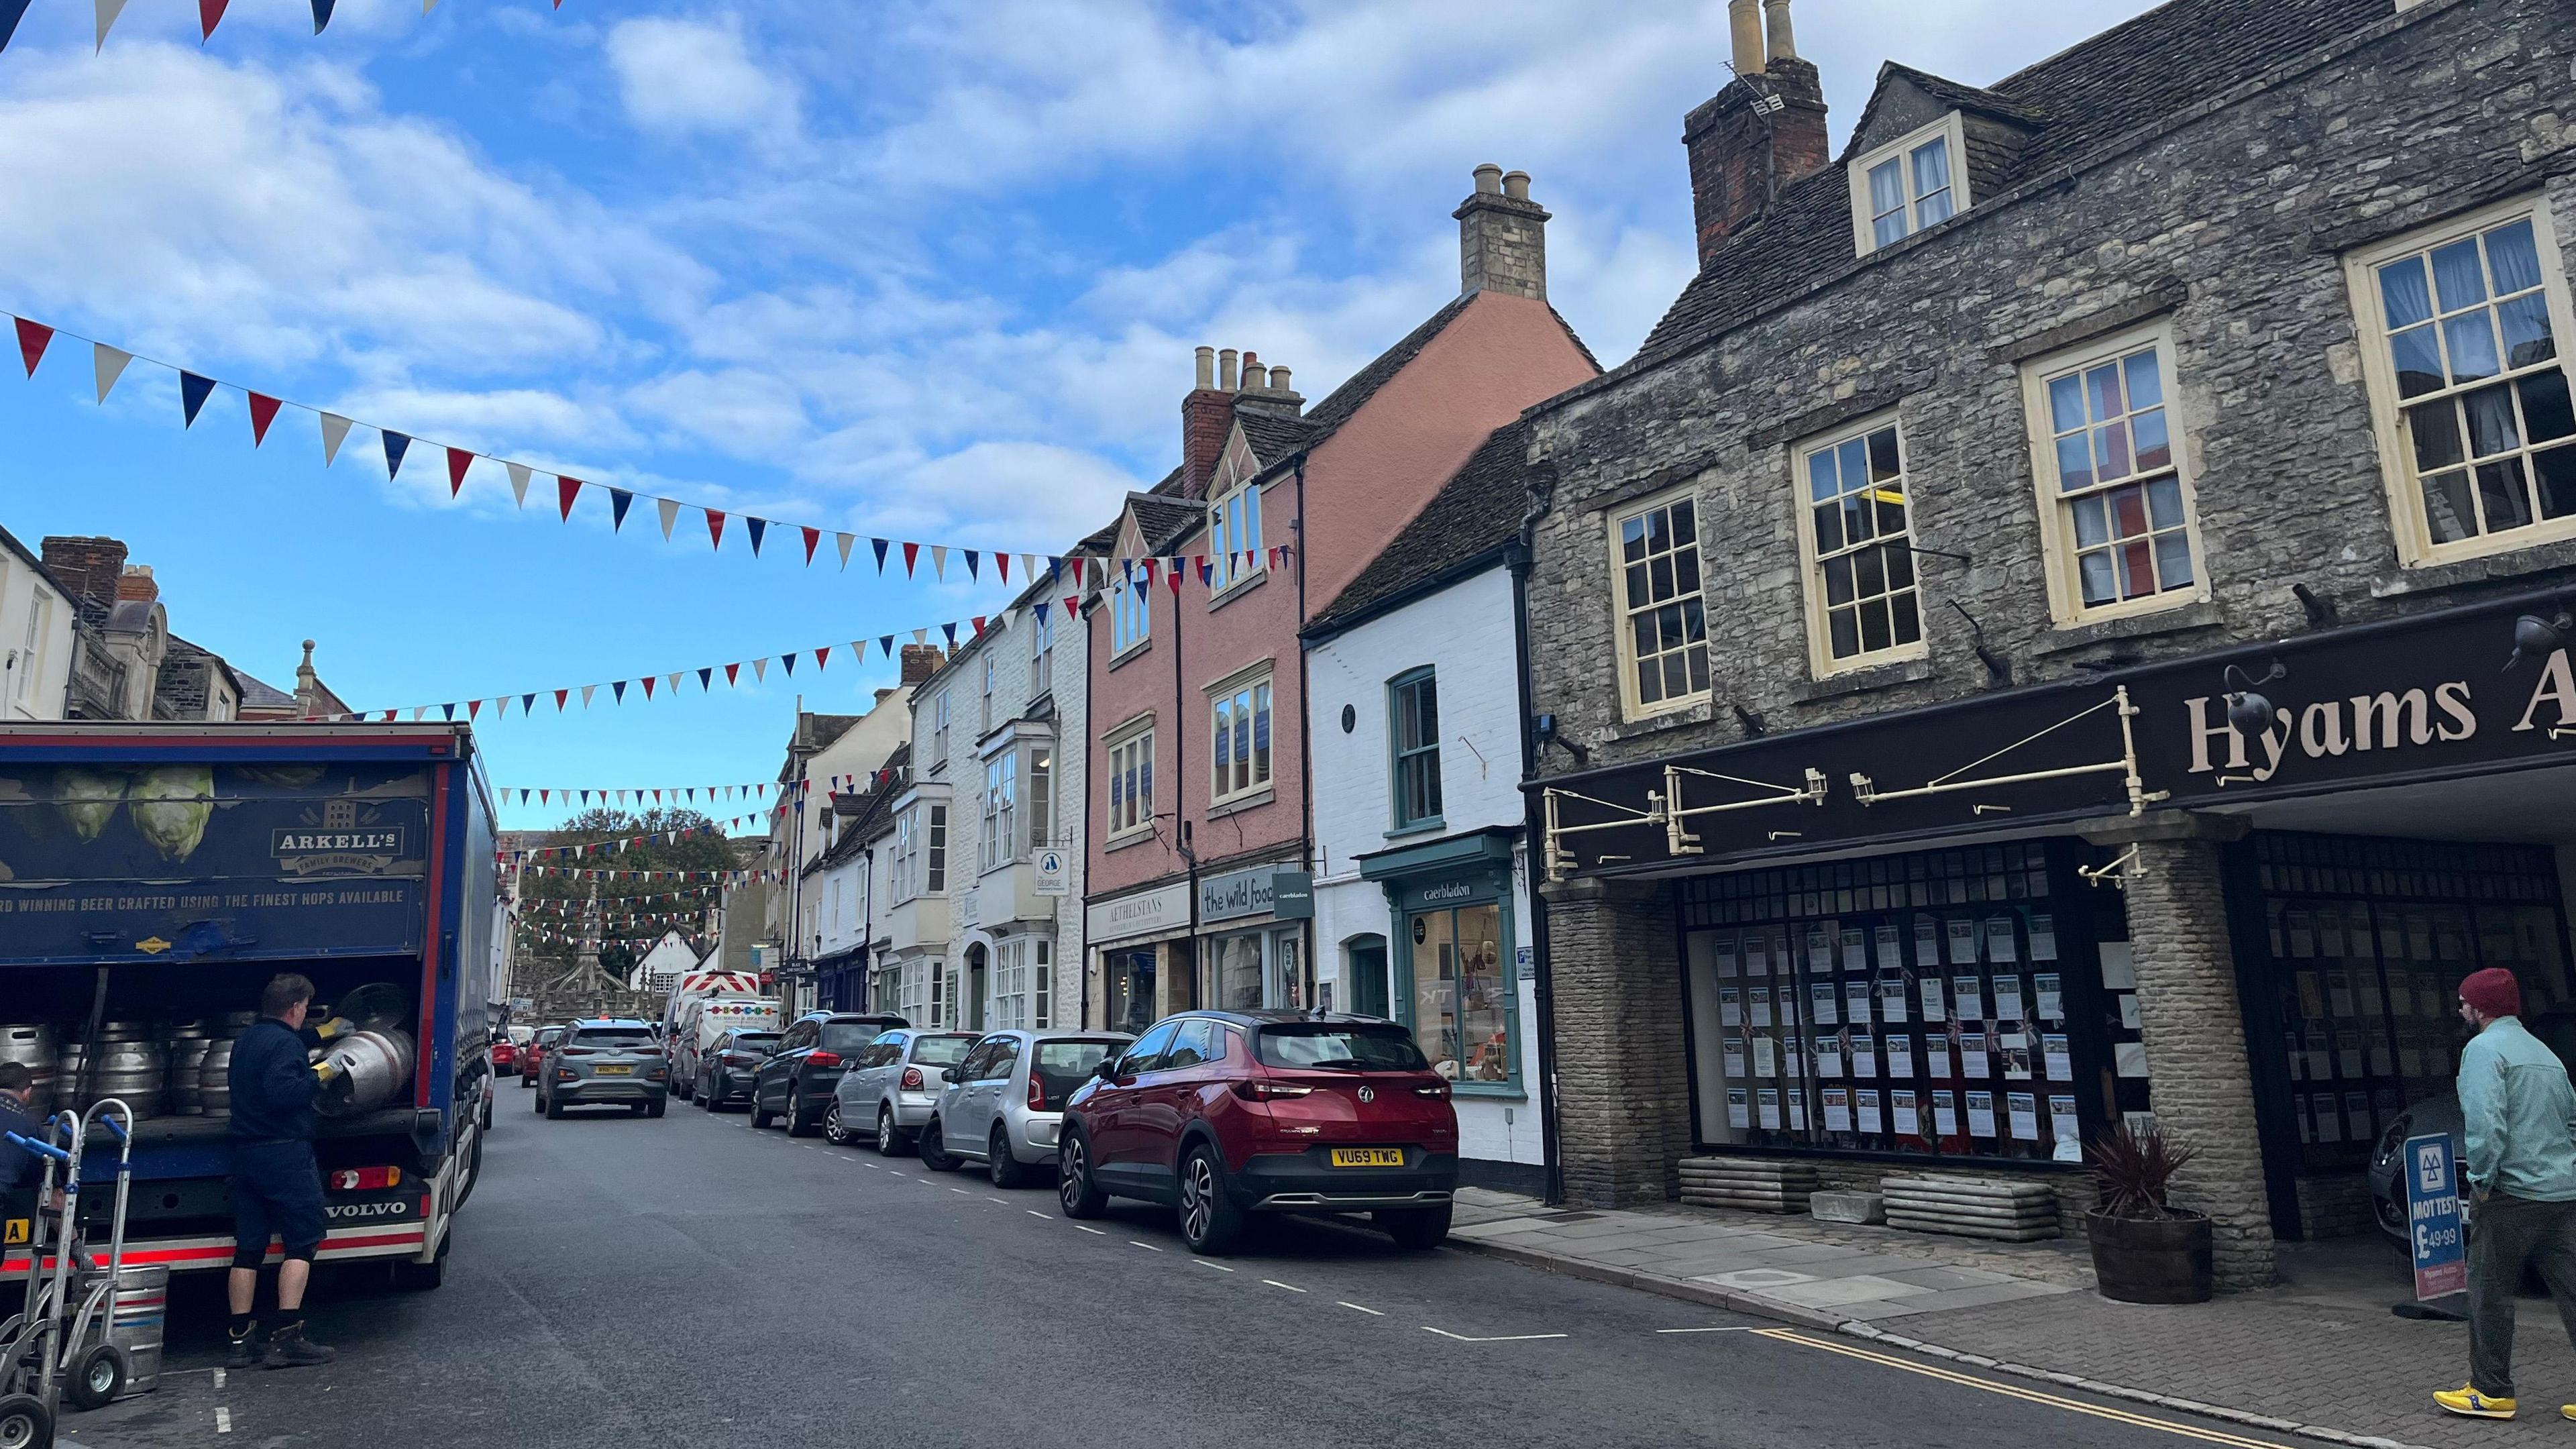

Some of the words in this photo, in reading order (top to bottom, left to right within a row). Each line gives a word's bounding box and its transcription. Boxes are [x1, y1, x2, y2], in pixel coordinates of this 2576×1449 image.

[2184, 680, 2477, 782] Hyams
[299, 856, 329, 871] FAMILY
[333, 855, 372, 869] BREWERS
[17, 898, 76, 912] WINNING
[80, 897, 113, 911] BEER
[117, 896, 176, 910] CRAFTED
[180, 895, 219, 909] USING
[225, 894, 248, 908] THE
[252, 893, 298, 907] FINEST
[301, 891, 334, 906] HOPS
[338, 890, 403, 904] AVAILABLE
[1204, 886, 1224, 913] the
[1226, 879, 1248, 909] wild
[1424, 881, 1470, 901] caerbladon
[1109, 896, 1163, 923] AETHELSTANS
[711, 1006, 773, 1016] ABACUS
[1337, 1150, 1371, 1163] VU69
[1373, 1150, 1398, 1163] TWG
[324, 1201, 407, 1218] VOLVO
[2412, 1199, 2435, 1220] MOT
[2434, 1195, 2458, 1217] TEST
